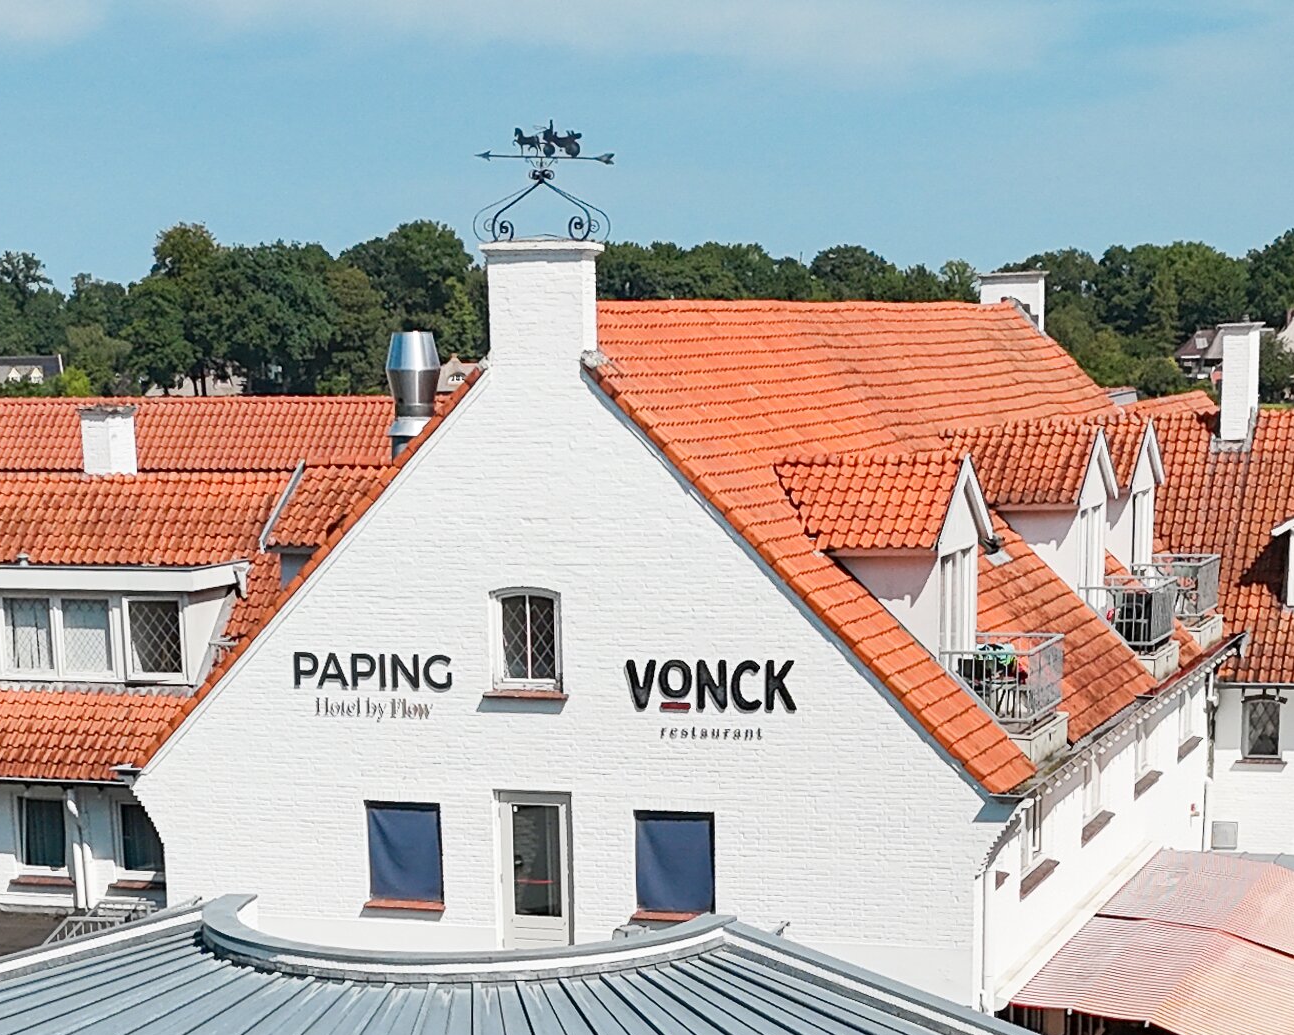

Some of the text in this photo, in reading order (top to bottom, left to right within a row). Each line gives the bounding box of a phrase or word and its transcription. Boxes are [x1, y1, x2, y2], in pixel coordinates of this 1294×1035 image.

[293, 651, 453, 691] PAPING
[625, 659, 797, 712] VONCK
[315, 697, 432, 722] Hotel by Flow
[660, 726, 763, 741] restaurant
